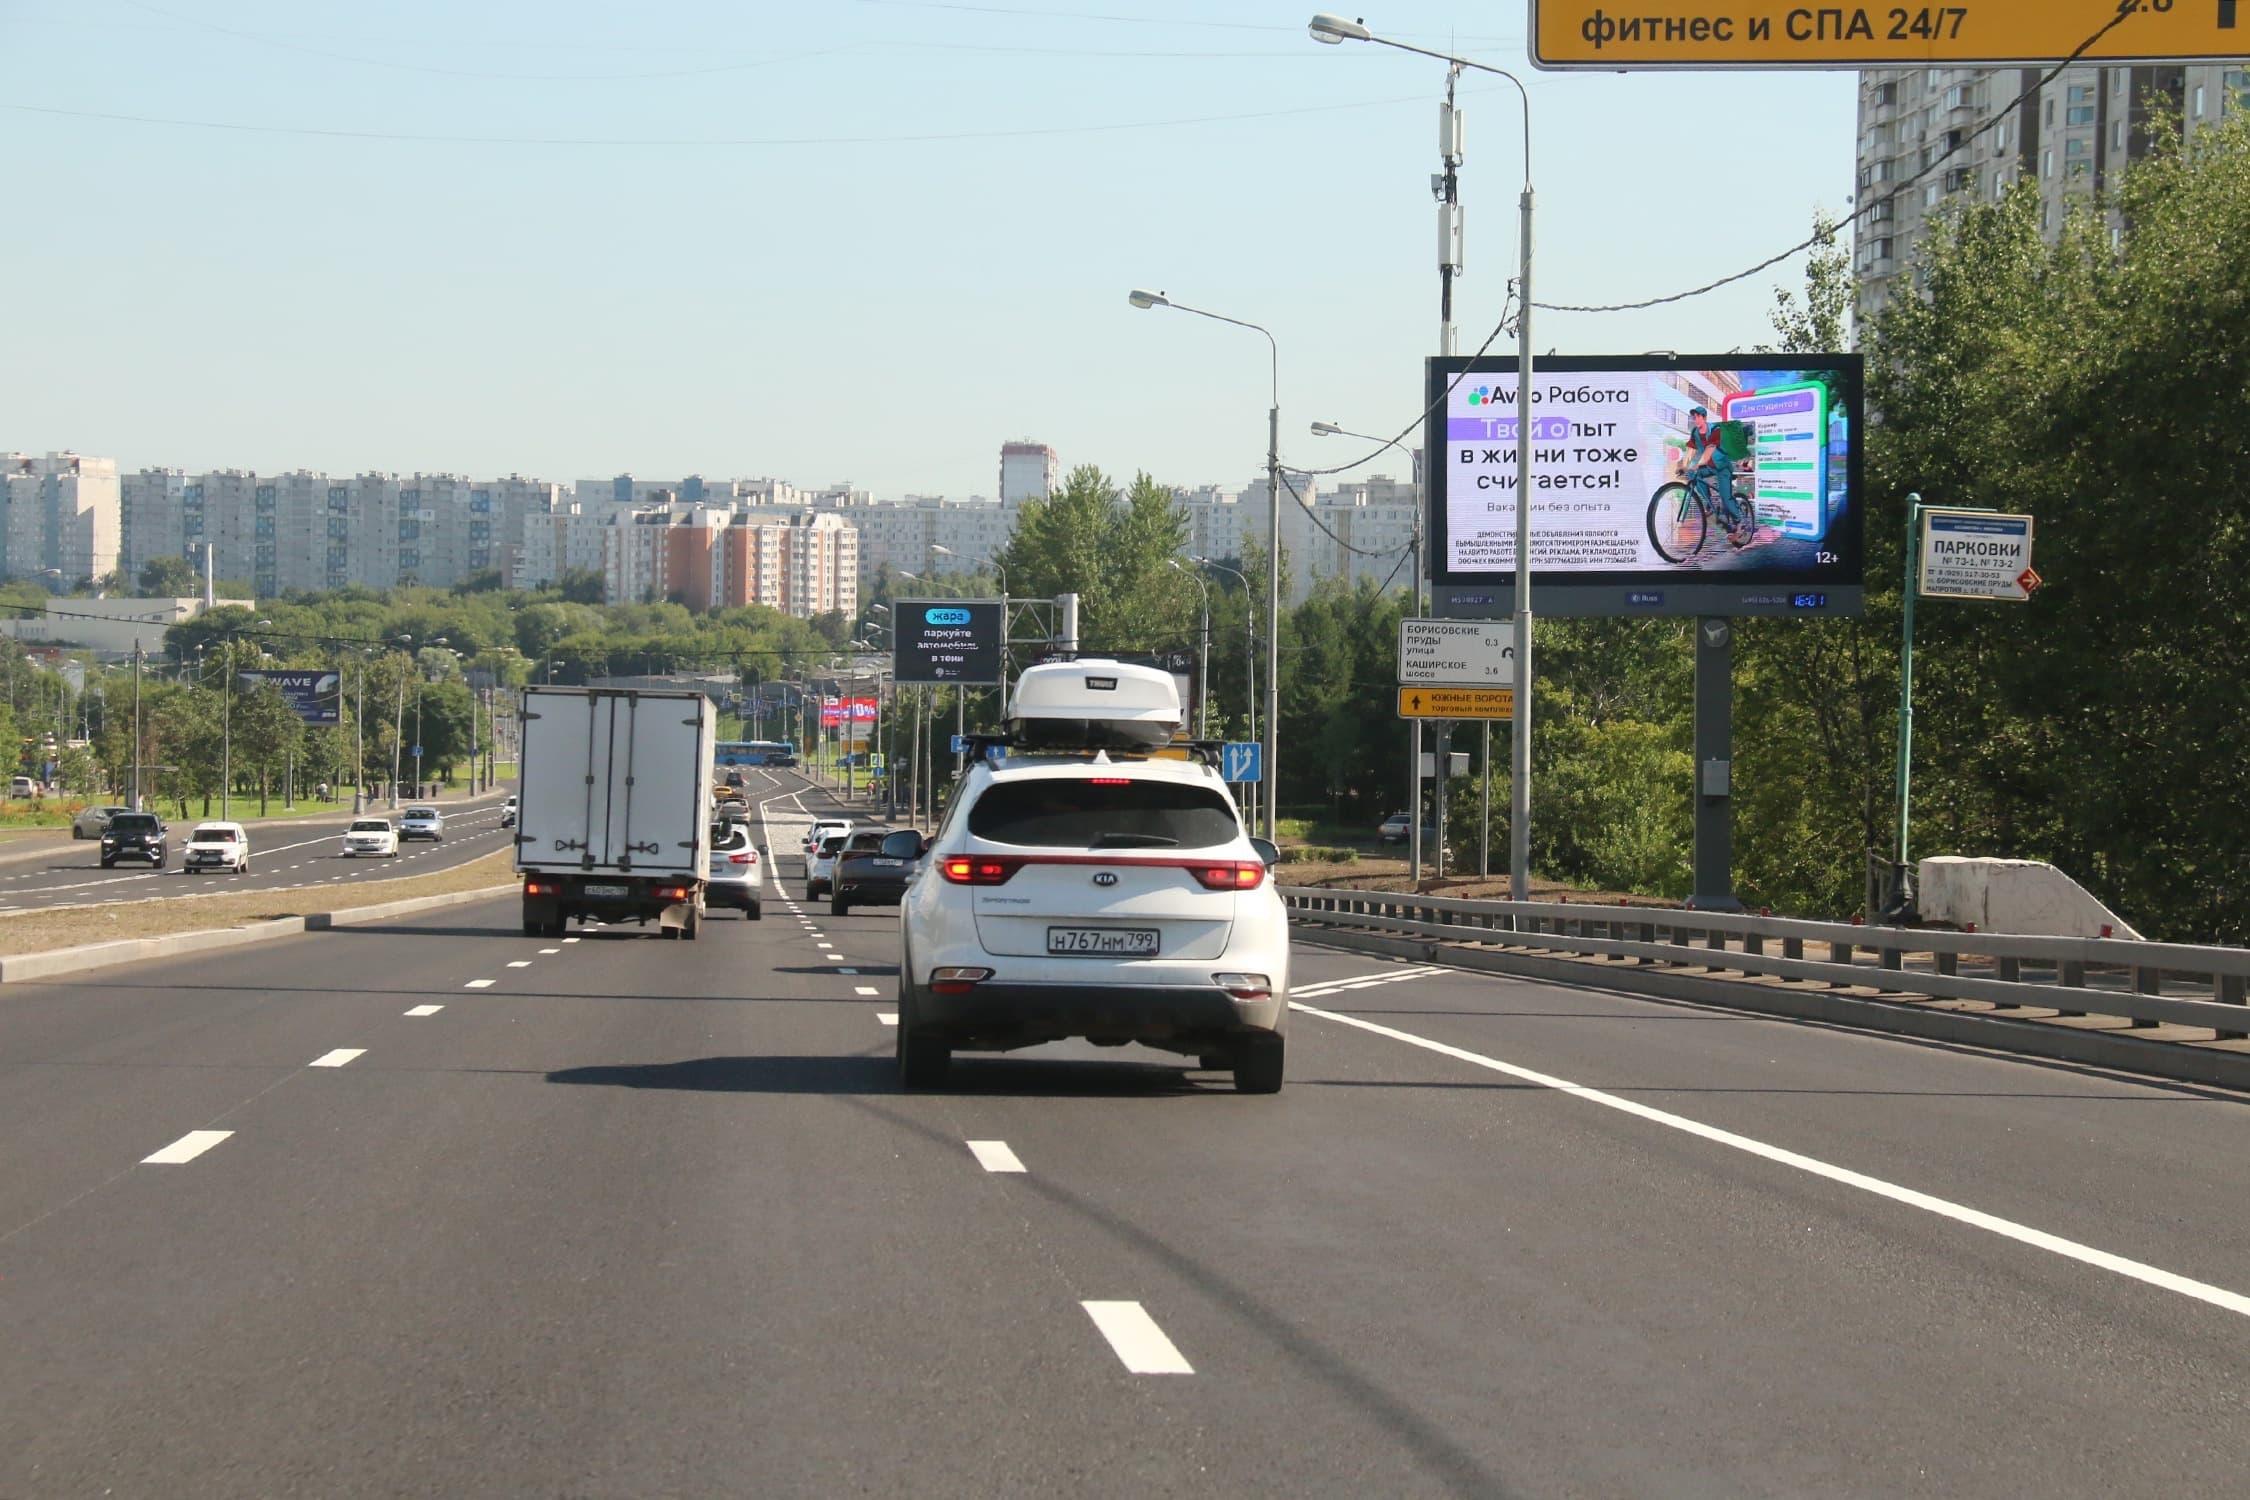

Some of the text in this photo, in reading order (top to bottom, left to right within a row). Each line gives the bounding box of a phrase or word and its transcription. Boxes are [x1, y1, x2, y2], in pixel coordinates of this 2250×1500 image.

[1581, 8, 1967, 49] фитнес и СПА 24/7
[1549, 385, 1629, 404] Работа
[1550, 422, 1617, 438] опыт
[1461, 448, 1638, 464] в жини тоже
[1487, 502, 1611, 513] Вакаии без опыта
[1934, 540, 2020, 557] ПАРКОВКИ
[1815, 551, 1840, 564] 12+
[1993, 560, 2013, 568] 73-2
[932, 612, 964, 622] жара
[924, 628, 972, 639] паркуйте
[1407, 625, 1480, 636] БОРИСОВСКИЕ
[1407, 636, 1441, 646] ПРУДЫ
[1406, 647, 1435, 655] улица
[1406, 660, 1468, 670] КАШИРСКОЕ
[1431, 694, 1472, 702] ЮЖНЫЕ
[1096, 874, 1114, 883] KIA
